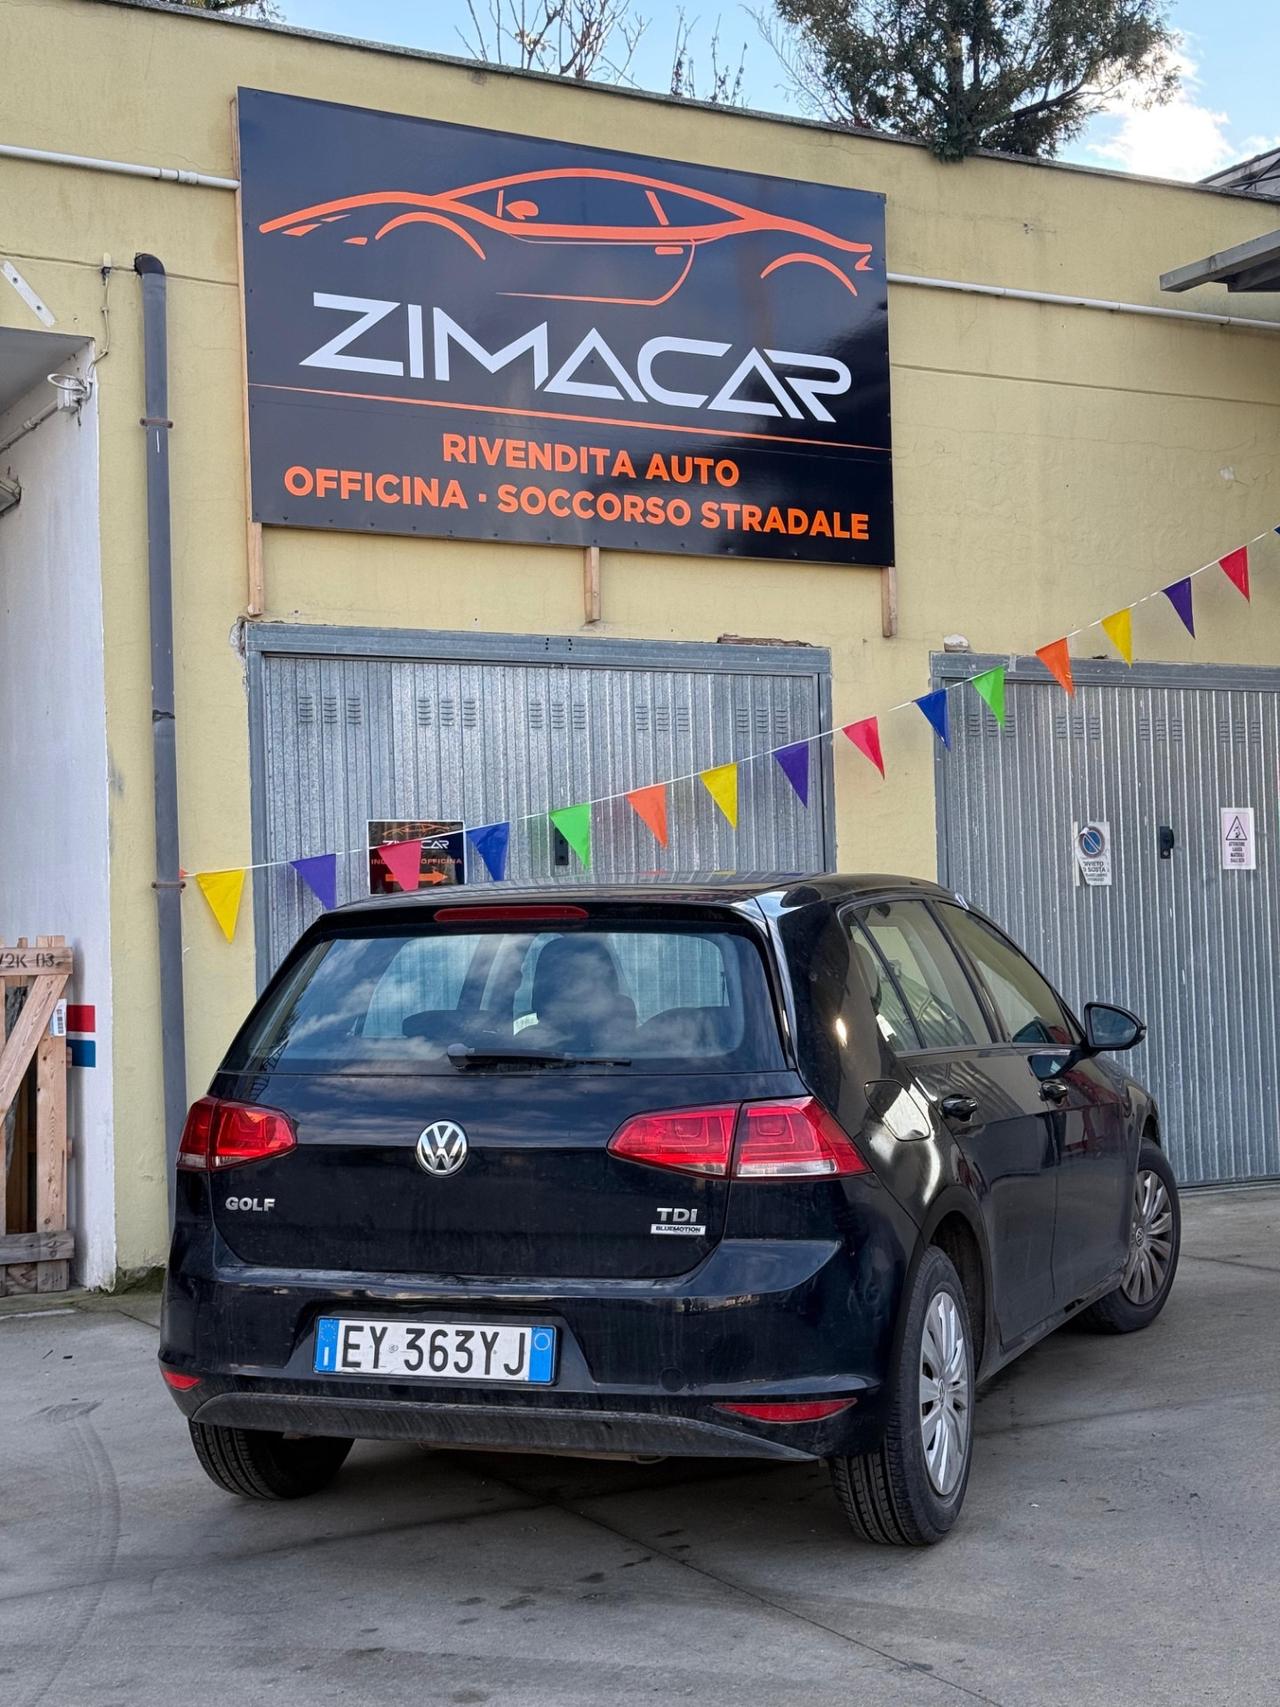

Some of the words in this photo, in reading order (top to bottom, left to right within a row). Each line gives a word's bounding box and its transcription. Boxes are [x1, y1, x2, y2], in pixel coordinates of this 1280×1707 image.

[299, 292, 851, 423] ZIMACAR
[442, 433, 636, 478] RIVENDITA
[645, 453, 740, 487] AUTO
[284, 465, 468, 509] OFFICINA
[497, 484, 691, 526] SOCCORSO
[700, 501, 869, 540] STRADALE
[225, 1196, 276, 1211] GOLF
[656, 1207, 698, 1222] TDI
[341, 1325, 388, 1369] EY
[404, 1328, 525, 1376] 363YJ
